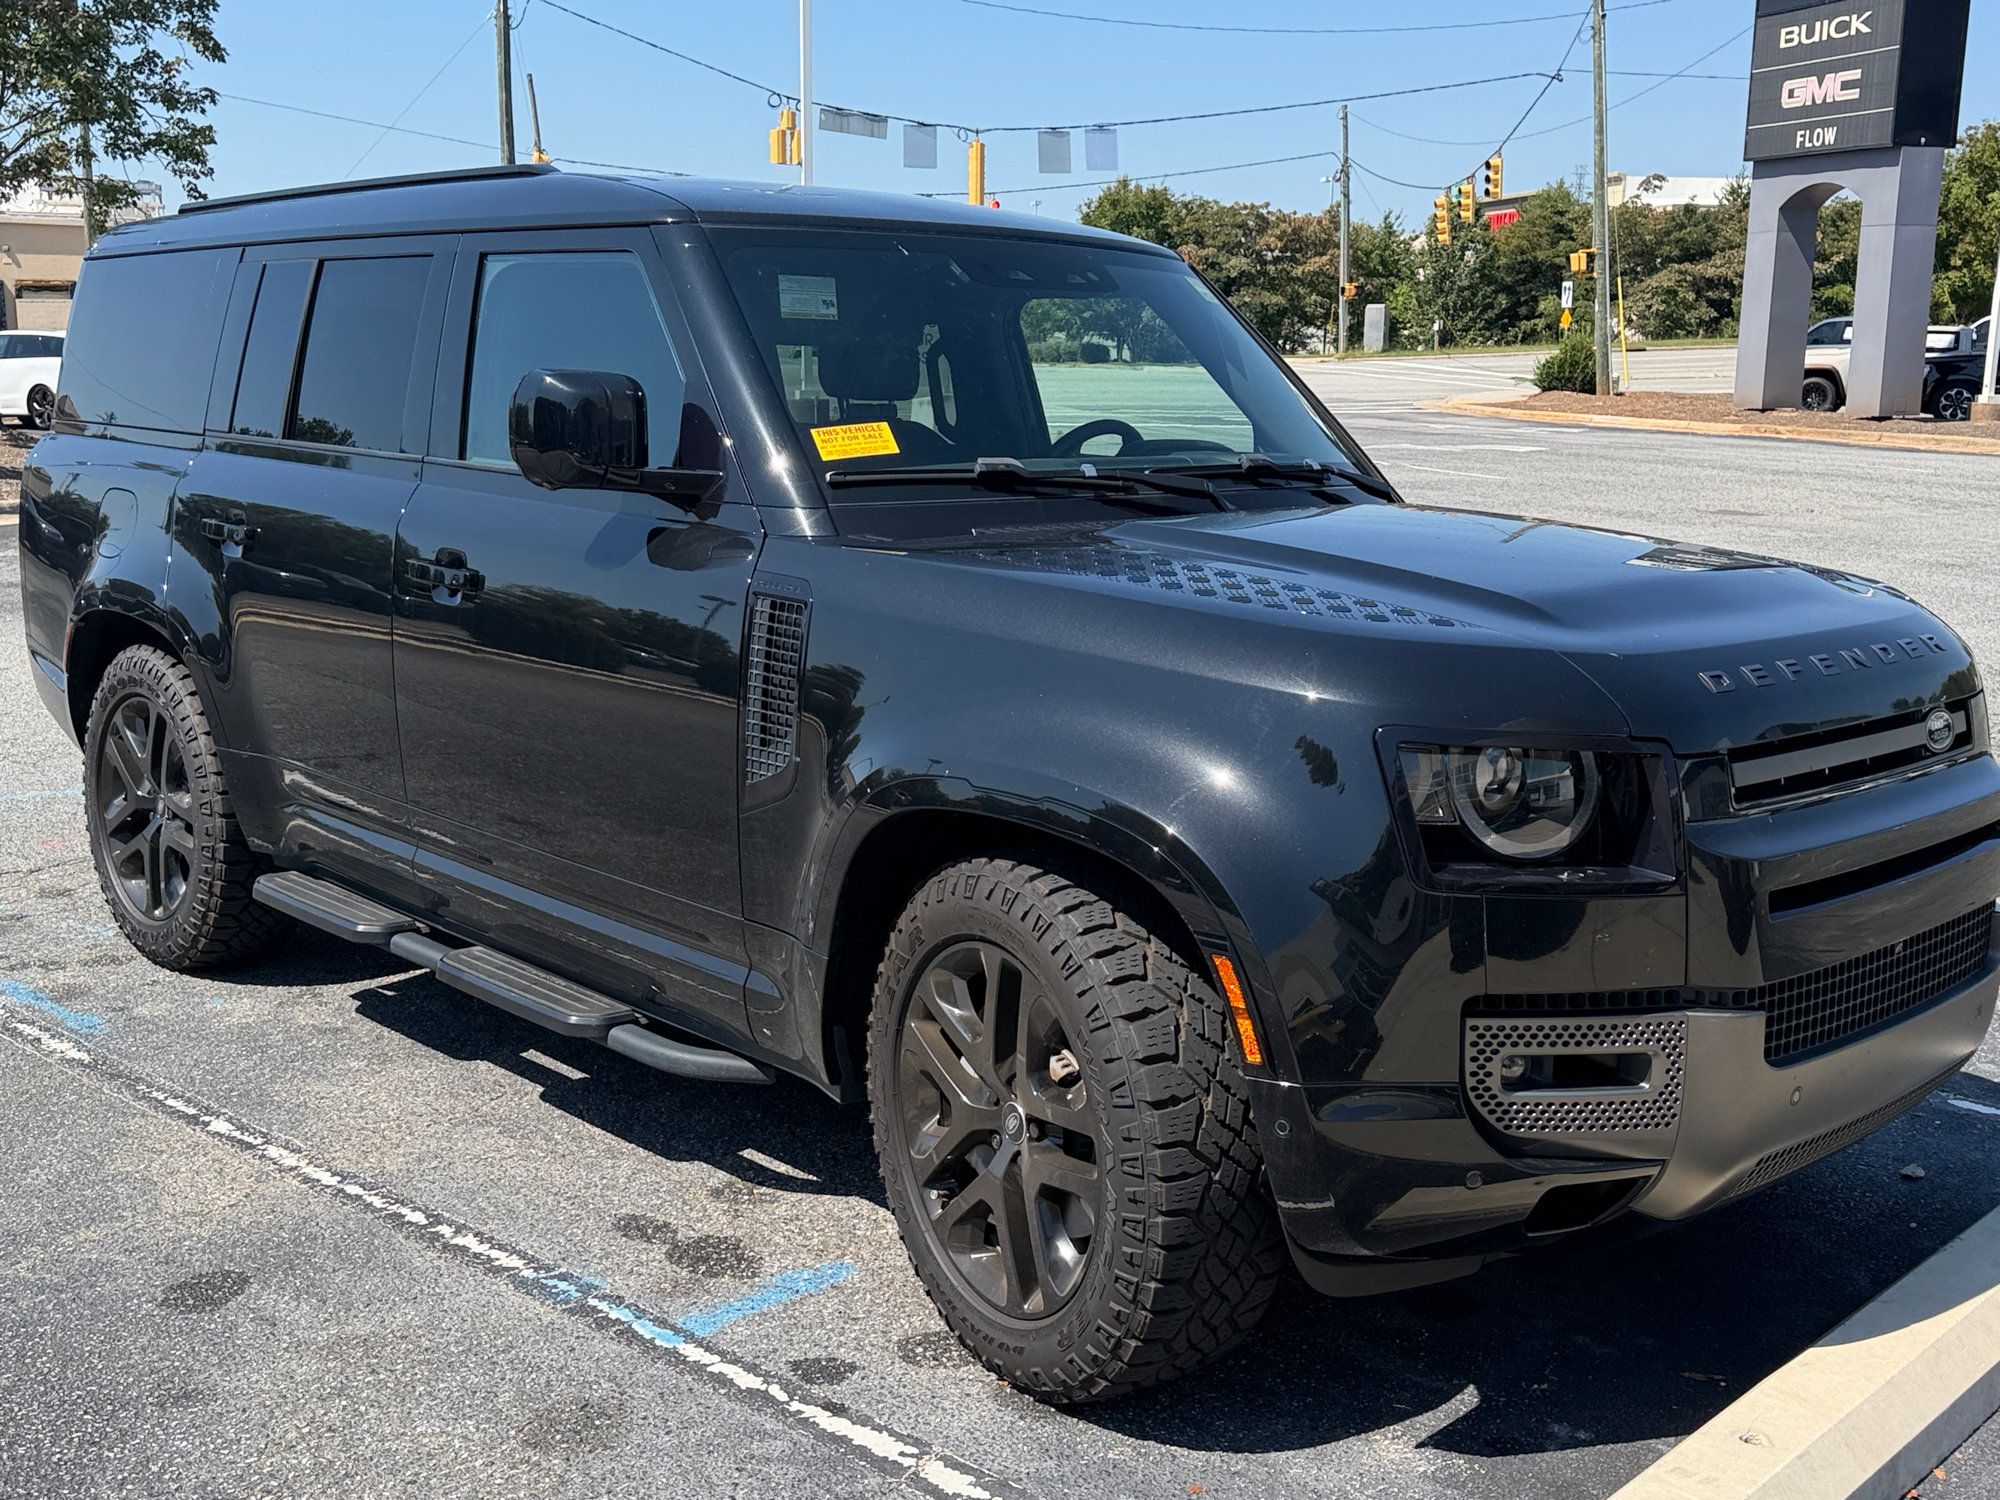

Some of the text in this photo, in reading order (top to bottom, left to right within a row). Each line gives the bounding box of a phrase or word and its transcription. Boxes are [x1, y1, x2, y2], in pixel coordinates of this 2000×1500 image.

[1779, 10, 1873, 49] BUICK
[1780, 68, 1863, 109] GMC
[1795, 126, 1838, 149] FLOW
[816, 424, 884, 437] THIS VEHICLE
[820, 437, 839, 445] NOT
[1697, 633, 1948, 694] DEFENDER
